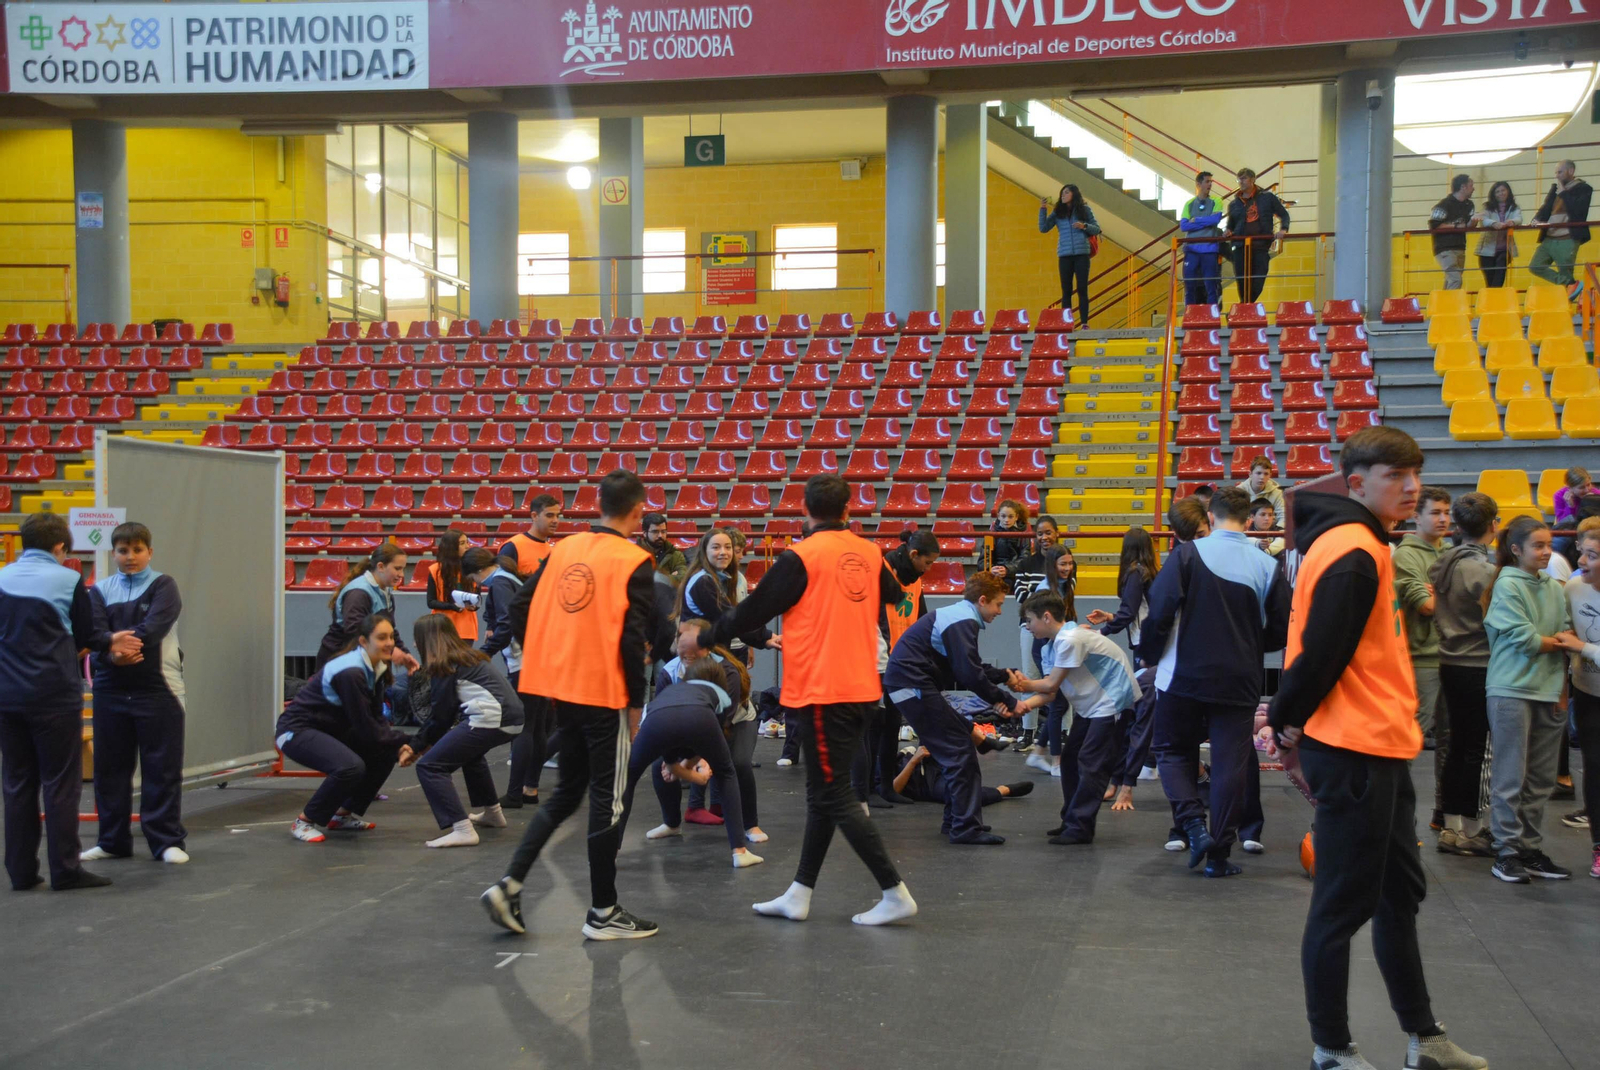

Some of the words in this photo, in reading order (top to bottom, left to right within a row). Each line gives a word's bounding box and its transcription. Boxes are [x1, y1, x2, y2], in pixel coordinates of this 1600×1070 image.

[186, 15, 389, 46] PATRIMONIO
[396, 16, 414, 28] DE
[628, 5, 753, 33] AYUNTAMIENTO
[396, 30, 414, 43] LA
[628, 40, 649, 61] DE
[653, 35, 735, 60] CÓRDOBA
[886, 47, 954, 63] Instituto
[959, 39, 1042, 60] Municipal
[1047, 38, 1069, 54] de
[1074, 33, 1155, 56] Deportes
[1160, 28, 1236, 48] Córdoba
[22, 55, 161, 84] CÓRDOBA
[185, 48, 417, 84] HUMANIDAD
[695, 139, 714, 162] G
